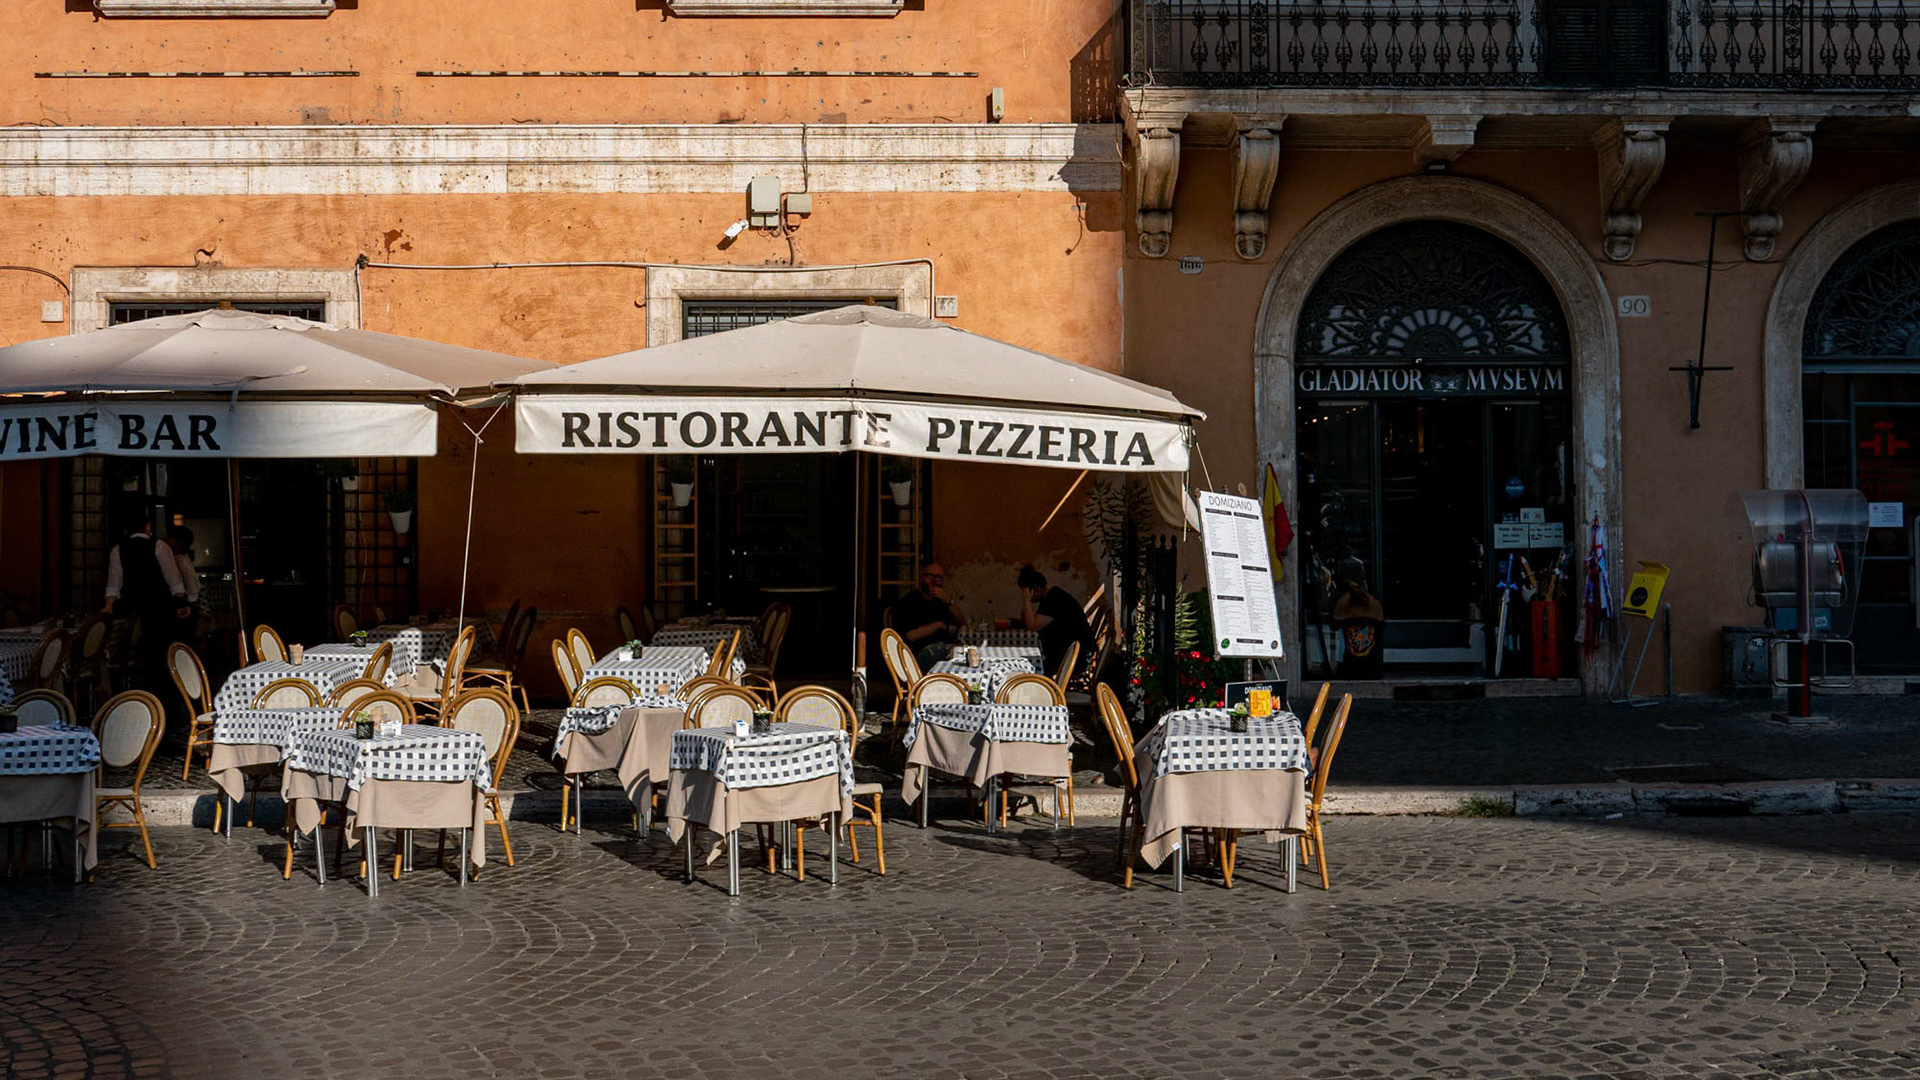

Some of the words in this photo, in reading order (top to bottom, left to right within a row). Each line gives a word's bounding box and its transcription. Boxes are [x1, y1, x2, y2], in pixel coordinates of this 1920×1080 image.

[1620, 298, 1647, 314] 90
[1299, 368, 1424, 391] GLADIATOR
[1466, 368, 1564, 391] MVSEVM
[118, 414, 221, 451] BAR
[562, 411, 891, 448] RISTORANTE
[926, 417, 1155, 466] PIZZERIA
[1208, 496, 1253, 511] DOMIZIANO
